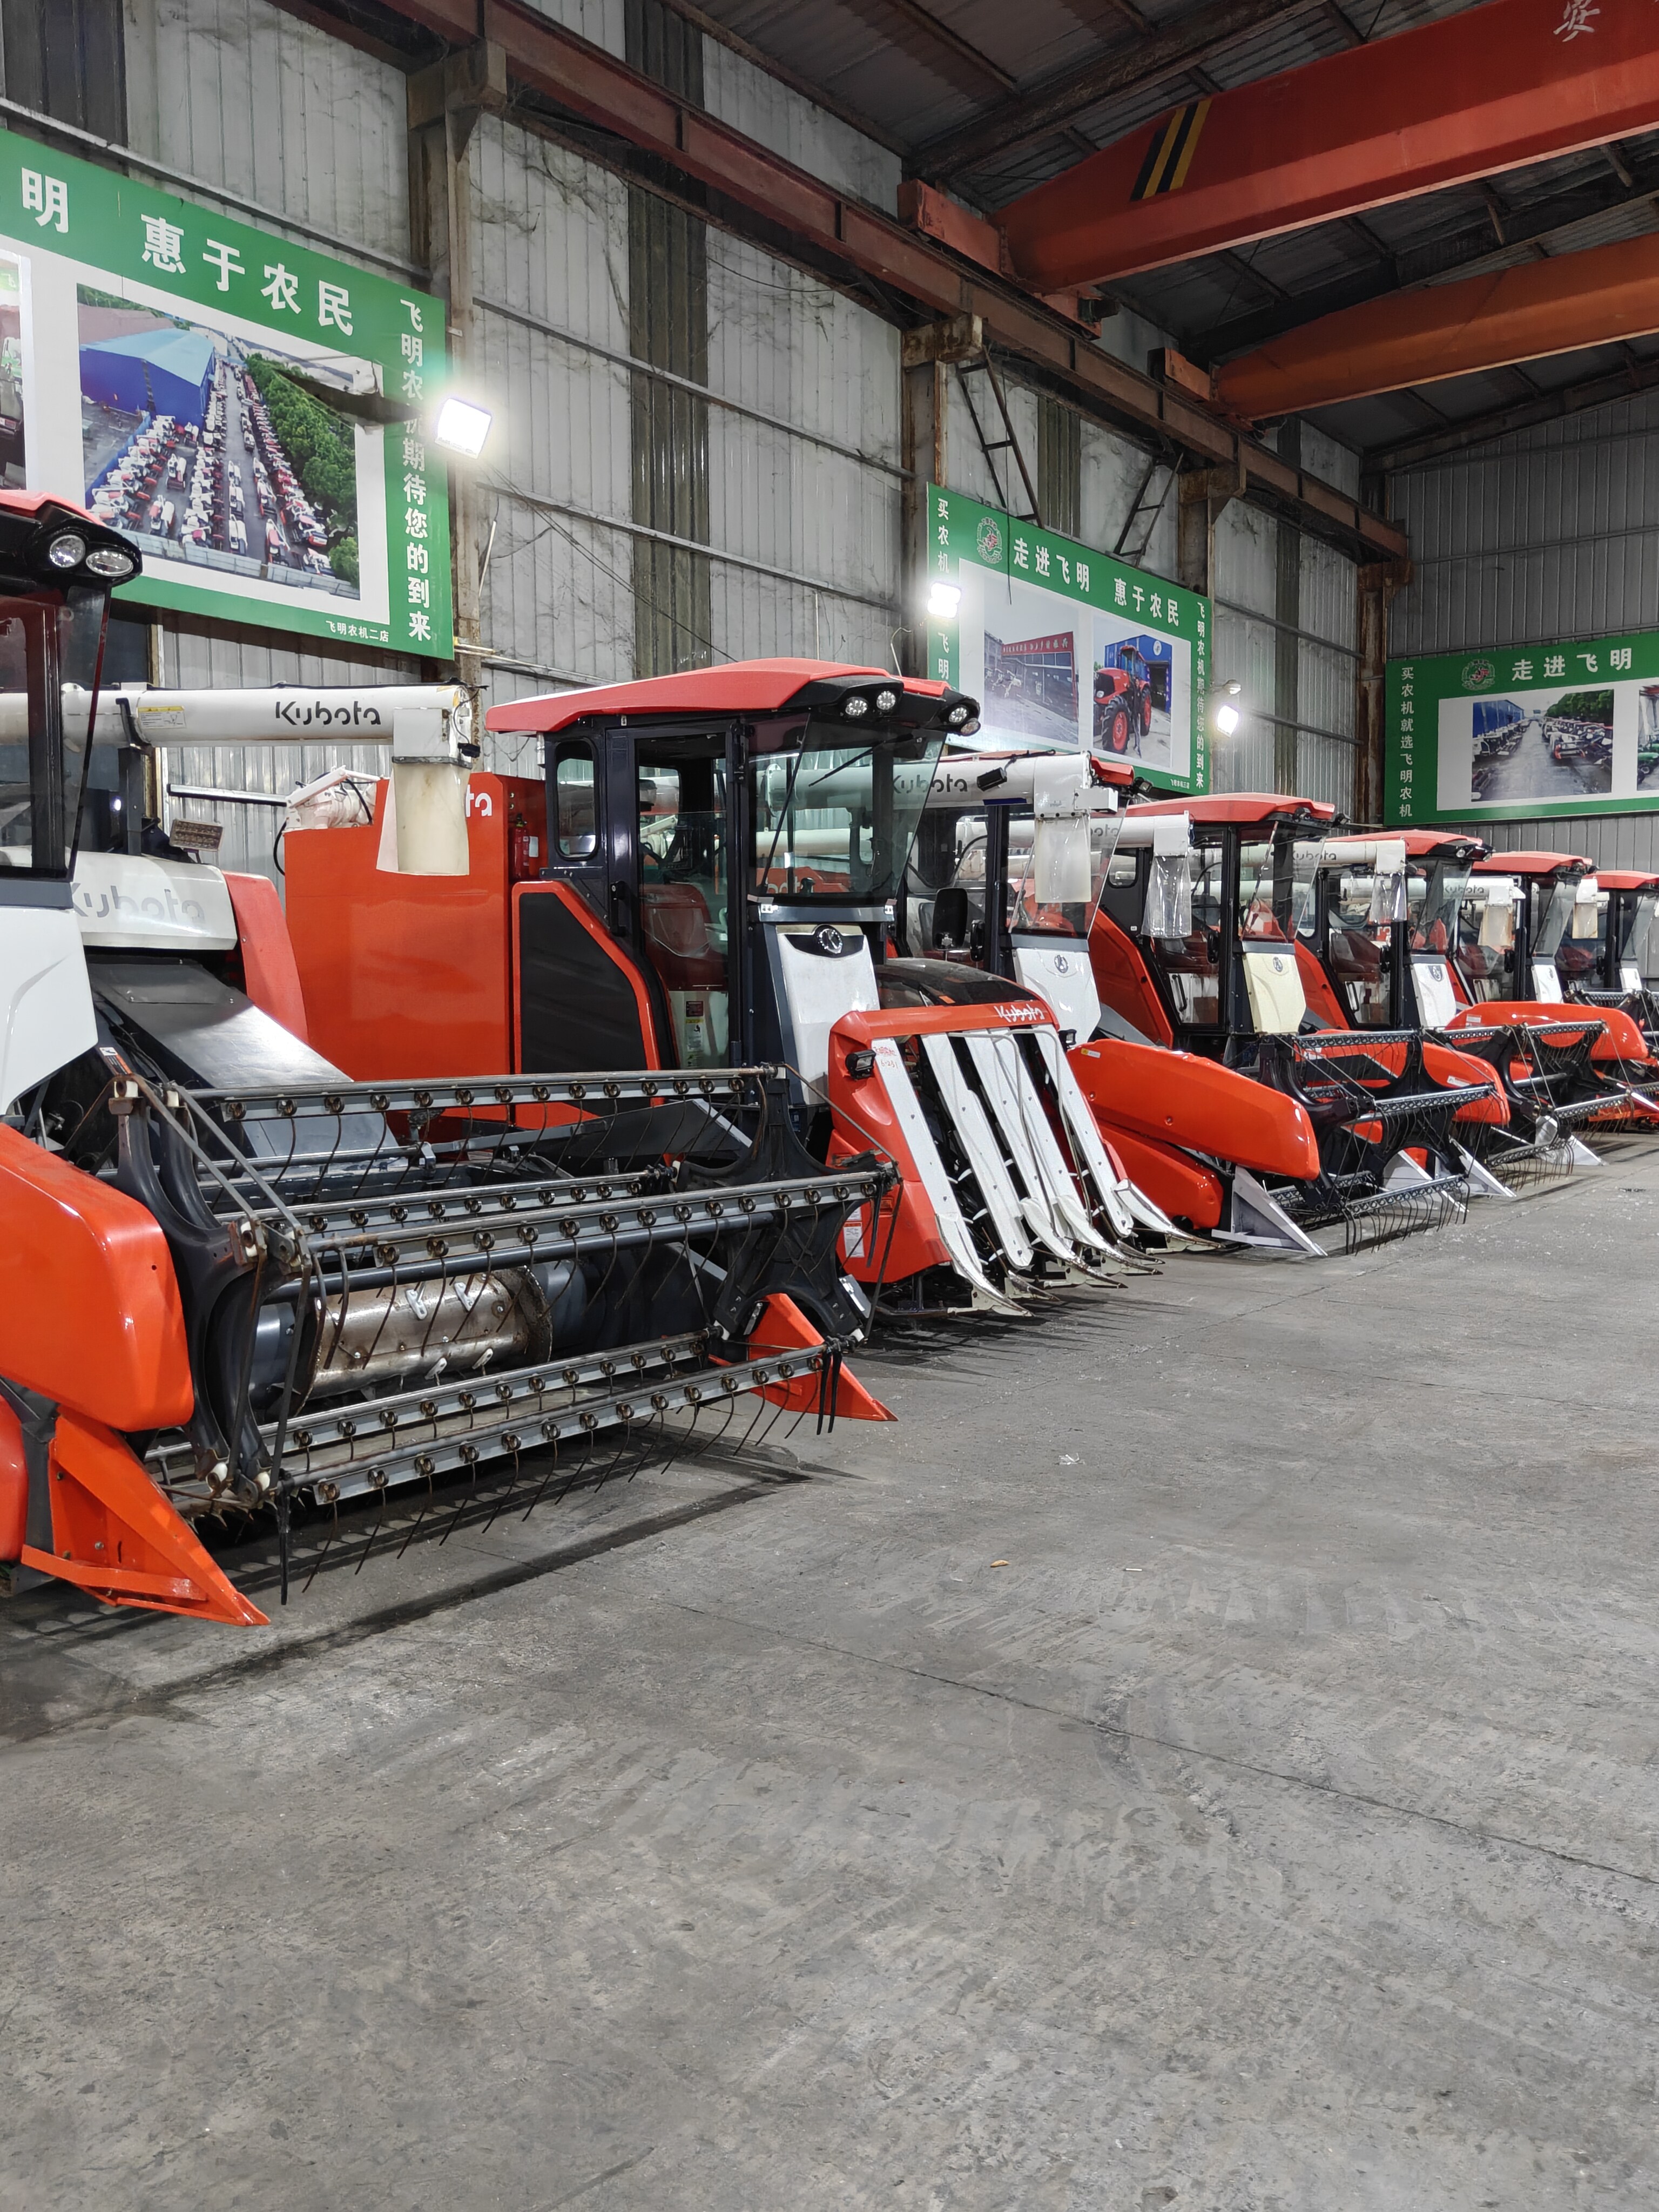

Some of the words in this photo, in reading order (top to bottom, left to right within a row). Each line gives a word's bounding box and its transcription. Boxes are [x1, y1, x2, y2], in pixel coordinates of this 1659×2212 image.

[21, 167, 69, 233] 明
[140, 213, 354, 337] 惠于农民
[1014, 538, 1090, 592] 走进飞明
[1114, 578, 1179, 626] 惠于农民
[325, 620, 389, 643] 飞明农机二店
[1512, 648, 1633, 682] 走进飞明
[275, 700, 381, 726] Kubota
[1399, 666, 1414, 818] 买农机就选飞明农机
[994, 1003, 1045, 1023] Kubota
